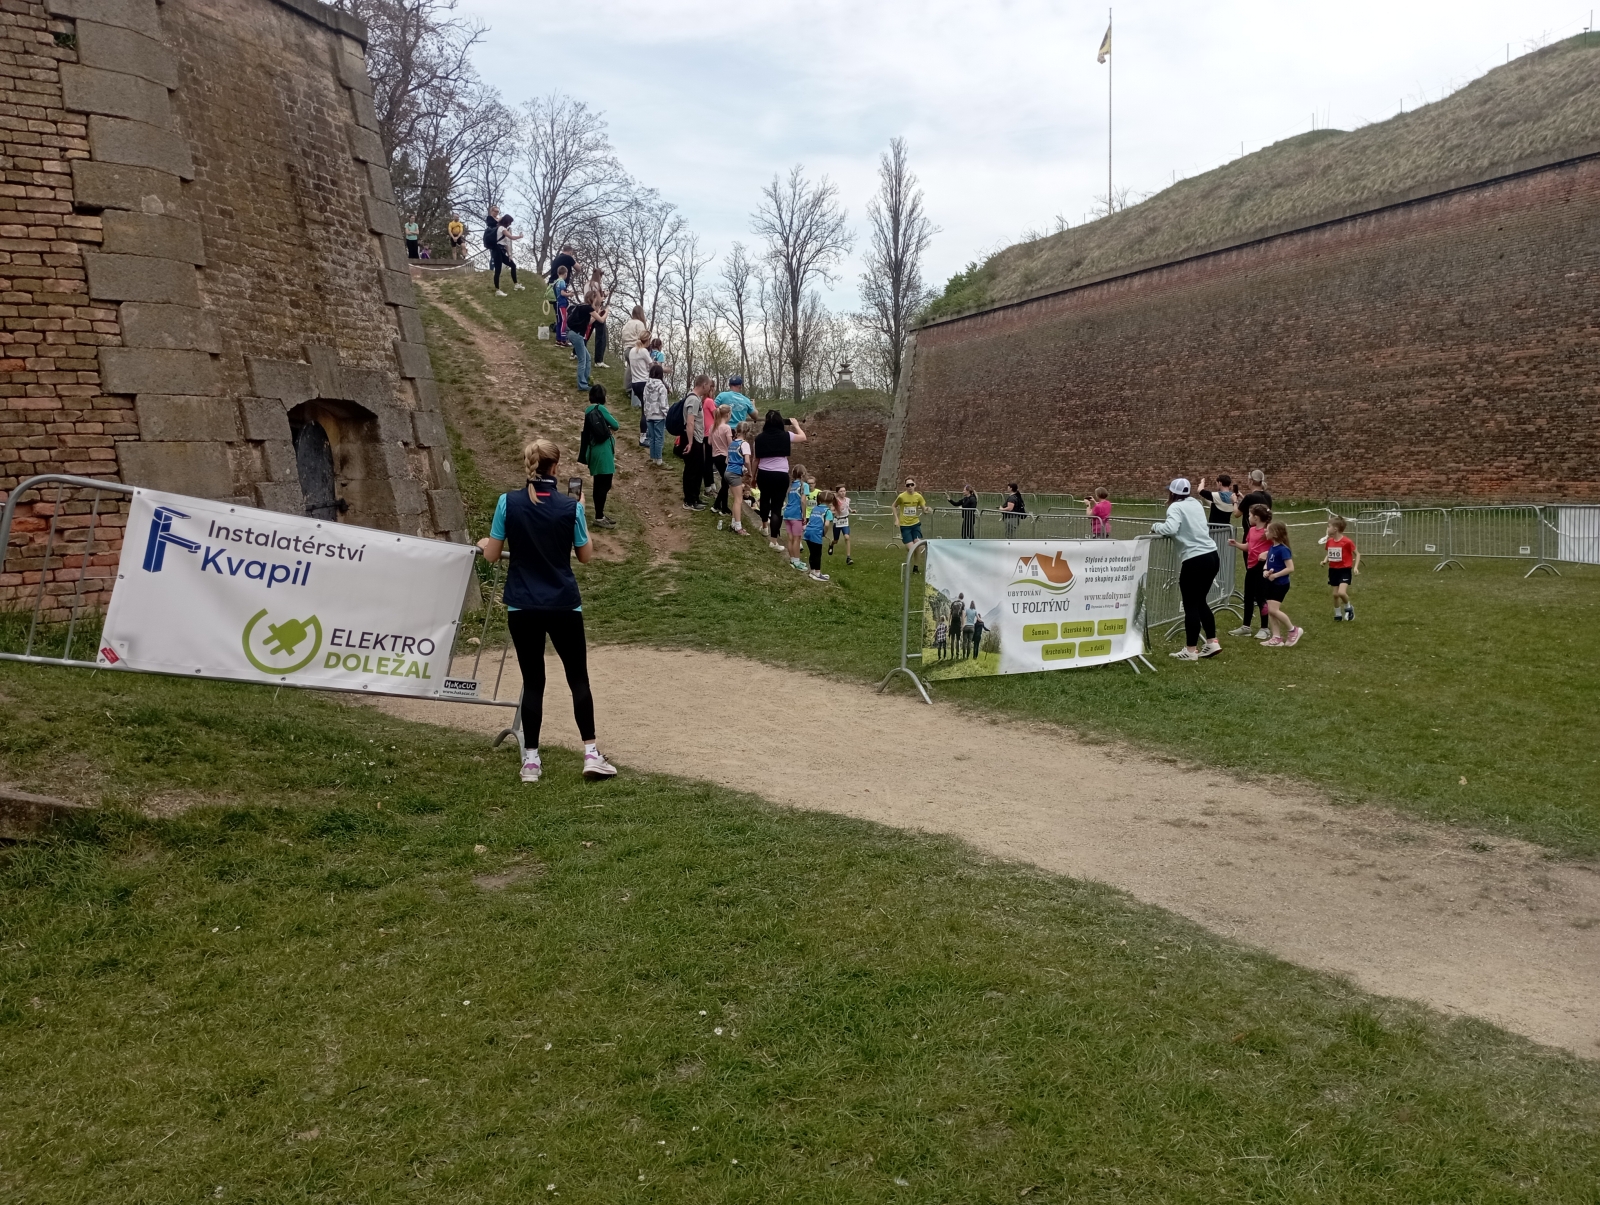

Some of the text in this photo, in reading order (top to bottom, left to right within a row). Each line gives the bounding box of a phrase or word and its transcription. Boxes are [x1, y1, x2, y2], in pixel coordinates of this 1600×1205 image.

[208, 520, 366, 563] Instalatérství
[1085, 556, 1104, 564] Stylové
[200, 547, 312, 588] Kvapil
[1089, 565, 1109, 574] různých
[1095, 576, 1114, 584] skupiny
[1007, 589, 1042, 597] UBYTOVÁNÍ
[1012, 598, 1070, 614] U FOLTÝNŮ
[1031, 628, 1050, 636] Šumava
[1063, 626, 1093, 634] Jizerské hory
[1103, 623, 1117, 632] Český
[330, 628, 436, 657] ELEKTRO
[1045, 647, 1073, 656] Hracholusky
[323, 651, 432, 680] DOLEŽAL
